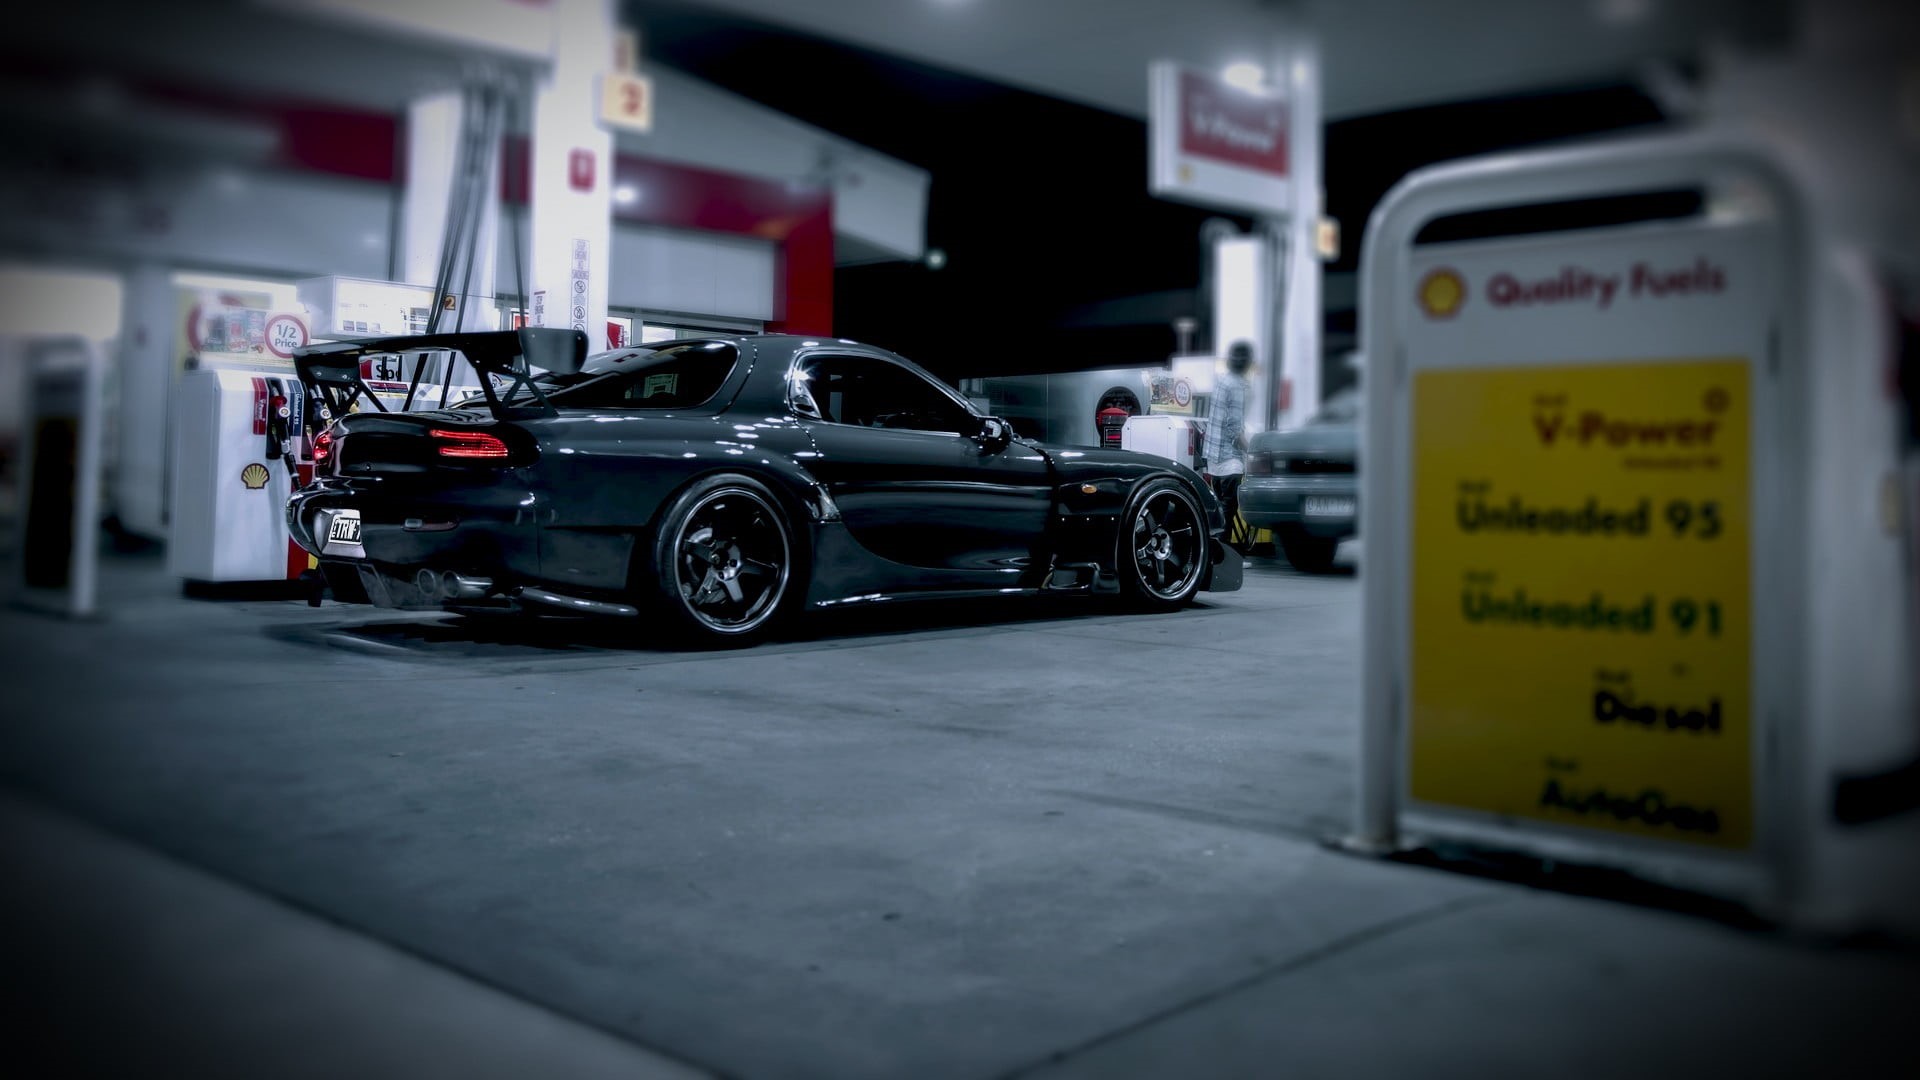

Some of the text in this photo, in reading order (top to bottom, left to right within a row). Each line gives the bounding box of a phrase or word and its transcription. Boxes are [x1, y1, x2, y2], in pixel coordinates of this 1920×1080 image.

[1485, 259, 1727, 311] Quality Fuels
[275, 338, 298, 348] Price
[277, 324, 297, 339] 1/2
[1534, 412, 1720, 449] V-Power
[1458, 496, 1722, 540] Unleaded 95
[1462, 588, 1722, 638] Unleaded 91
[1595, 691, 1721, 733] Diesel
[1541, 781, 1719, 833] AutoGas
